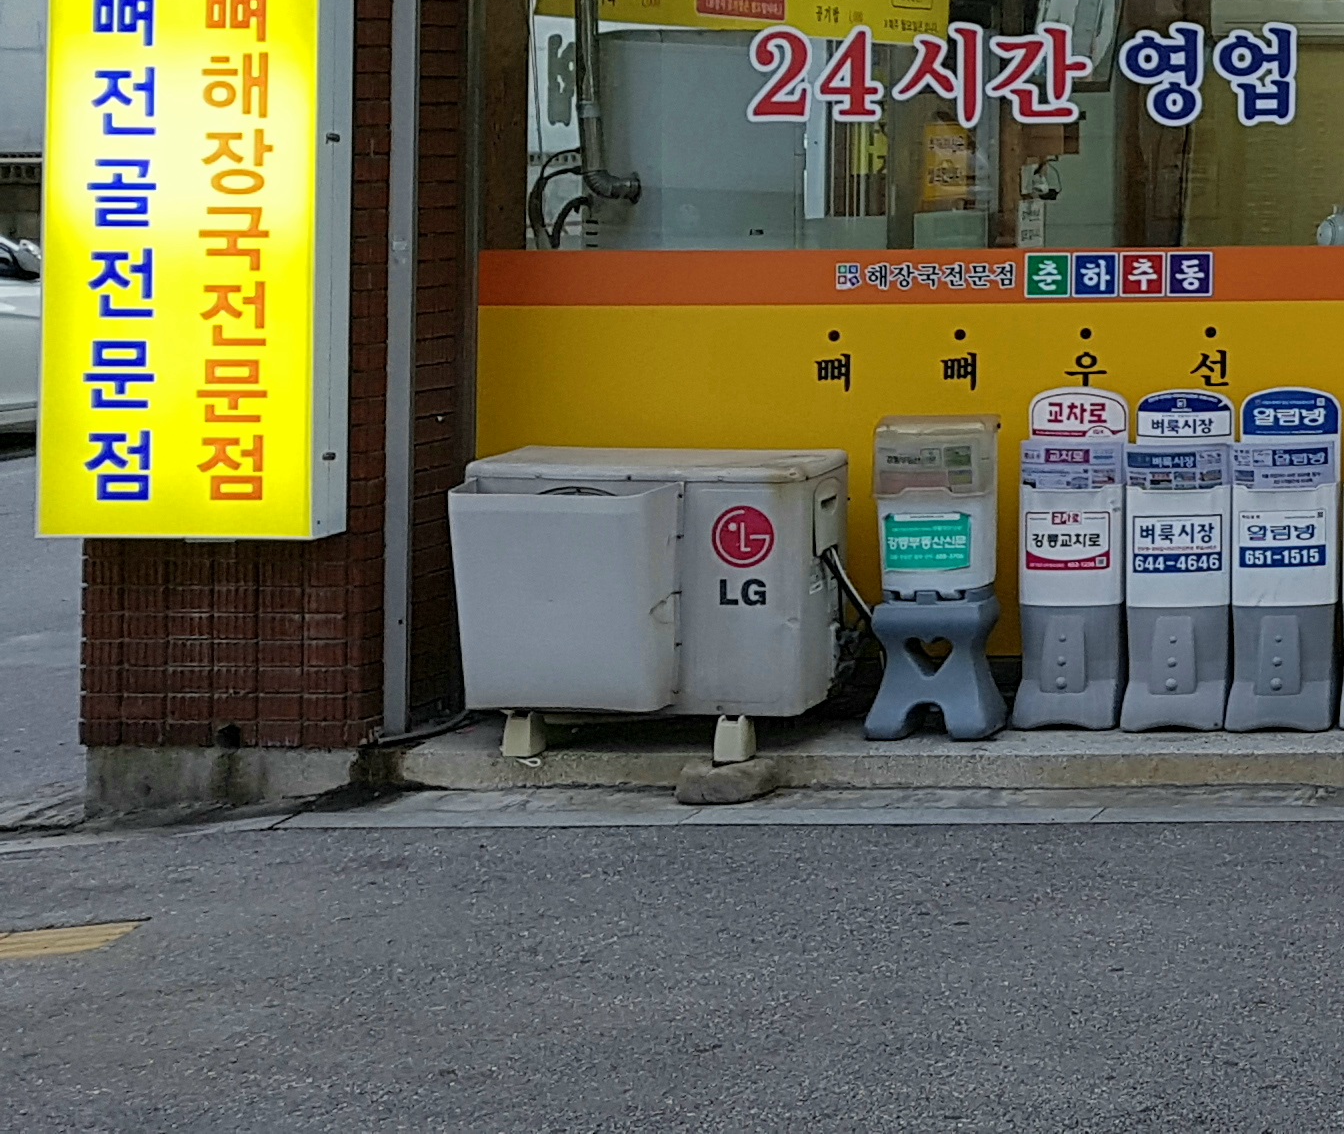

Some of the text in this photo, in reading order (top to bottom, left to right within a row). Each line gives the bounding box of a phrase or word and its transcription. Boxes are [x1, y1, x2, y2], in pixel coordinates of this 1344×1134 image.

[747, 22, 1298, 128] 24시간 영업
[865, 262, 1017, 291] 해장국전문점
[1046, 401, 1108, 425] 교차로
[1252, 406, 1327, 427] 알림방
[1150, 418, 1215, 435] 벼룩시장
[1151, 455, 1195, 469] 벼룩시장
[1031, 532, 1102, 549] 강릉교차로
[1139, 521, 1216, 545] 벼룩시장
[1246, 523, 1318, 541] 알림방
[1134, 554, 1220, 572] 644-4646
[1245, 548, 1320, 565] 651-1515
[718, 578, 768, 607] LG
